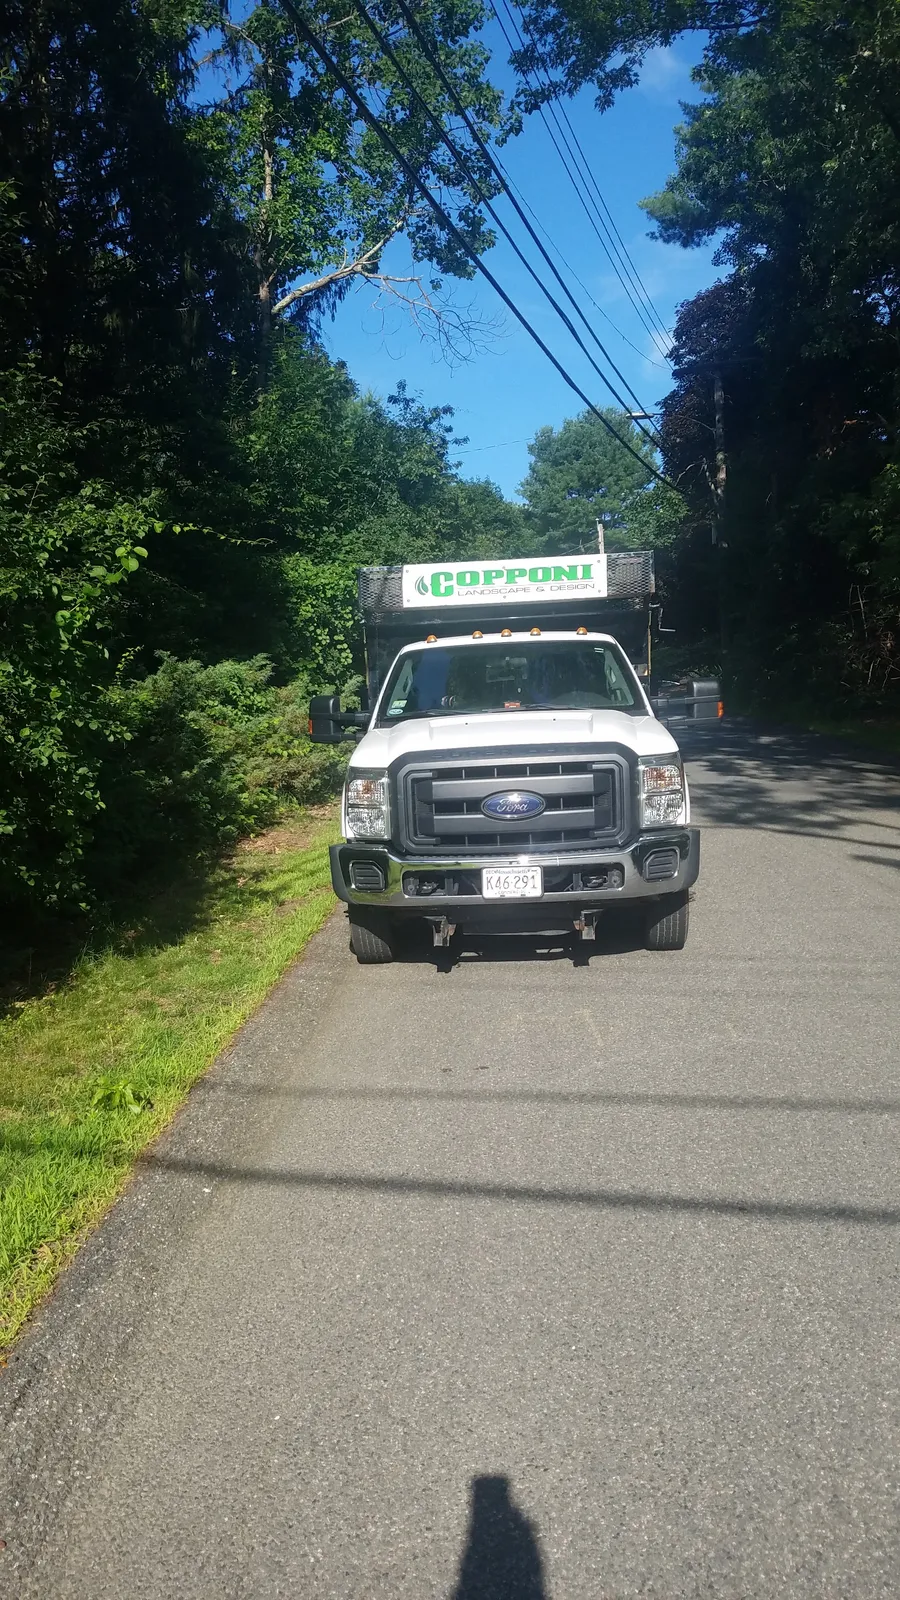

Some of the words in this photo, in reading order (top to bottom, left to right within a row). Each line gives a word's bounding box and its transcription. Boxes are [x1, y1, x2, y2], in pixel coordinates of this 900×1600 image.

[430, 564, 594, 597] COPPONI
[457, 586, 531, 596] LANDSCAPE
[550, 583, 595, 591] DESIGN
